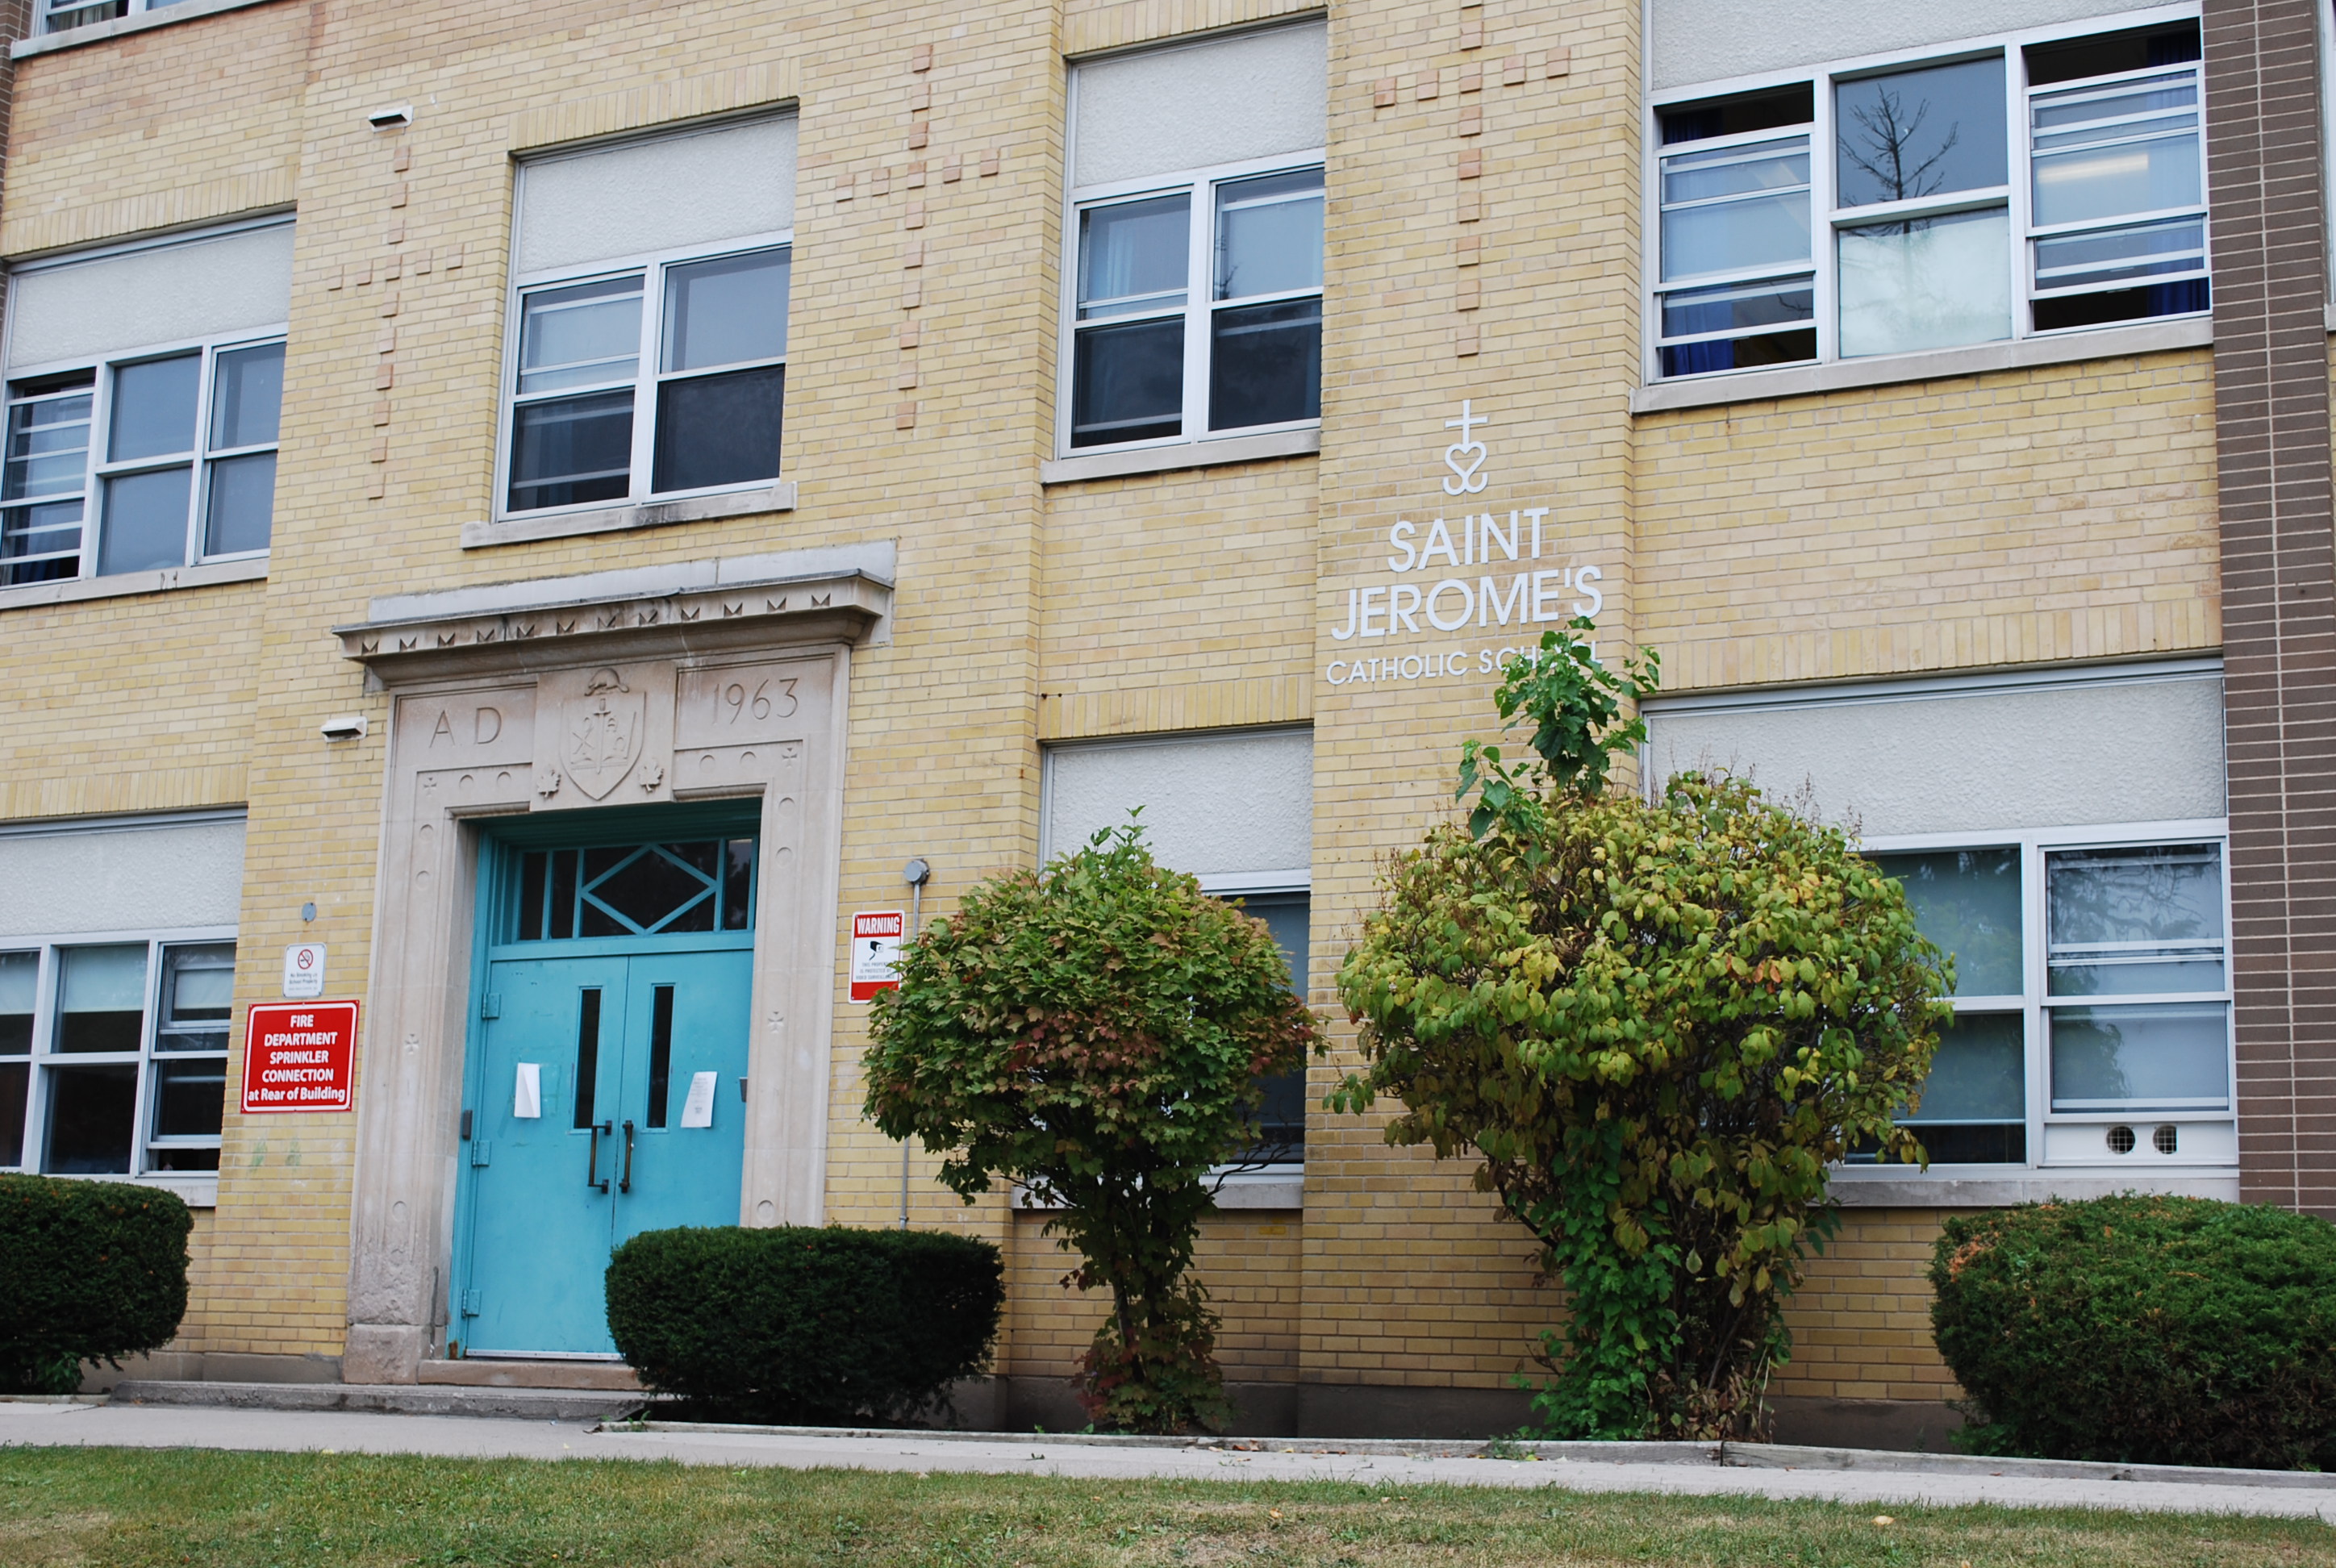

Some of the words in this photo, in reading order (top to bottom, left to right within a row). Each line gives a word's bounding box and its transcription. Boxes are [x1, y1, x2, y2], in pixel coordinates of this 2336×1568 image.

[1387, 507, 1550, 573] SAINT
[1330, 565, 1603, 641] JEROME'S
[1325, 650, 1469, 686] CATHOLIC
[711, 678, 799, 725] 1963
[857, 916, 900, 935] WARNING
[290, 1014, 315, 1028] FIRE
[264, 1032, 338, 1047] DEPARTMENT
[269, 1050, 329, 1065] SPRINKLER
[261, 1068, 335, 1082] CONNECTION
[248, 1089, 259, 1101] at
[261, 1087, 286, 1101] Rear
[286, 1086, 299, 1100] of
[300, 1086, 345, 1103] Building
